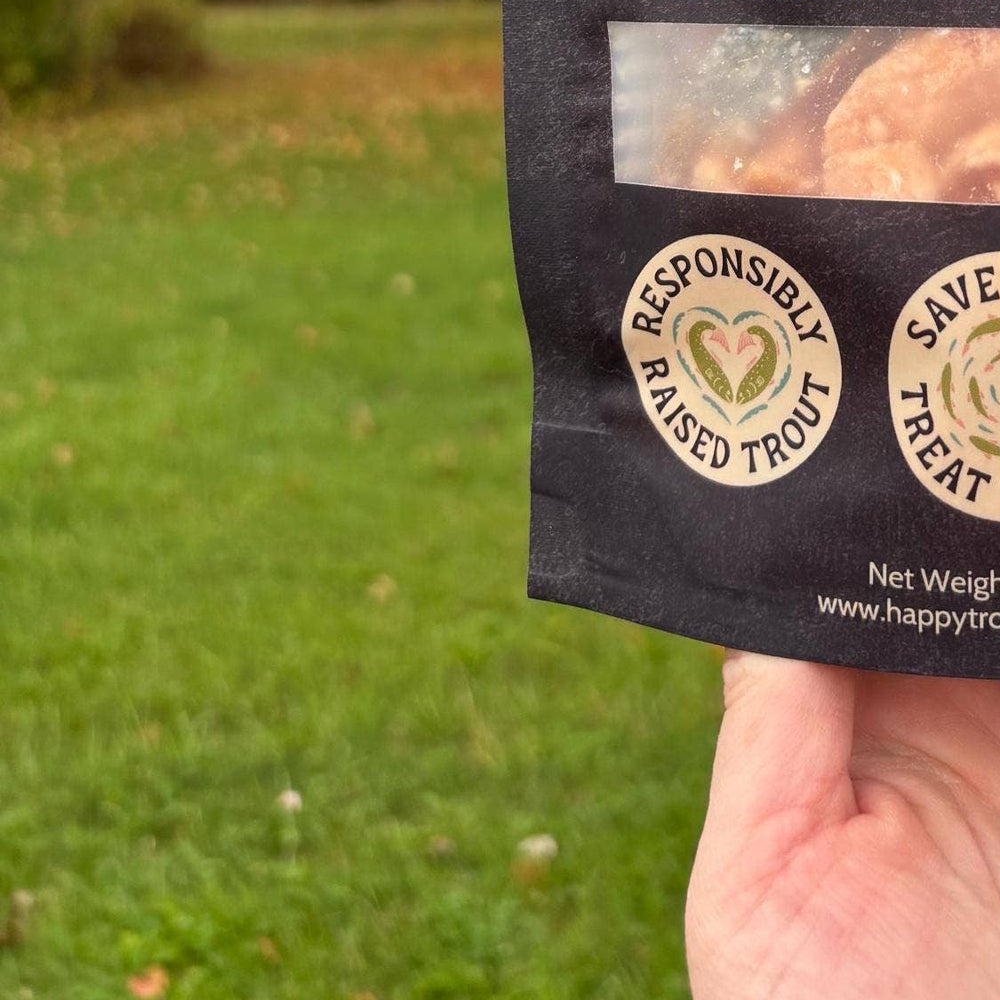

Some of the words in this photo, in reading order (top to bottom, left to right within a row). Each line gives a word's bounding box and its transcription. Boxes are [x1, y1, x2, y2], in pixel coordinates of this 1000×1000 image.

[632, 247, 828, 344] RESPONSIBLY
[907, 266, 1000, 350] SAVE
[641, 356, 731, 469] RAISED
[741, 371, 830, 473] TROUT
[900, 382, 992, 502] TREAT
[868, 561, 914, 591] Net
